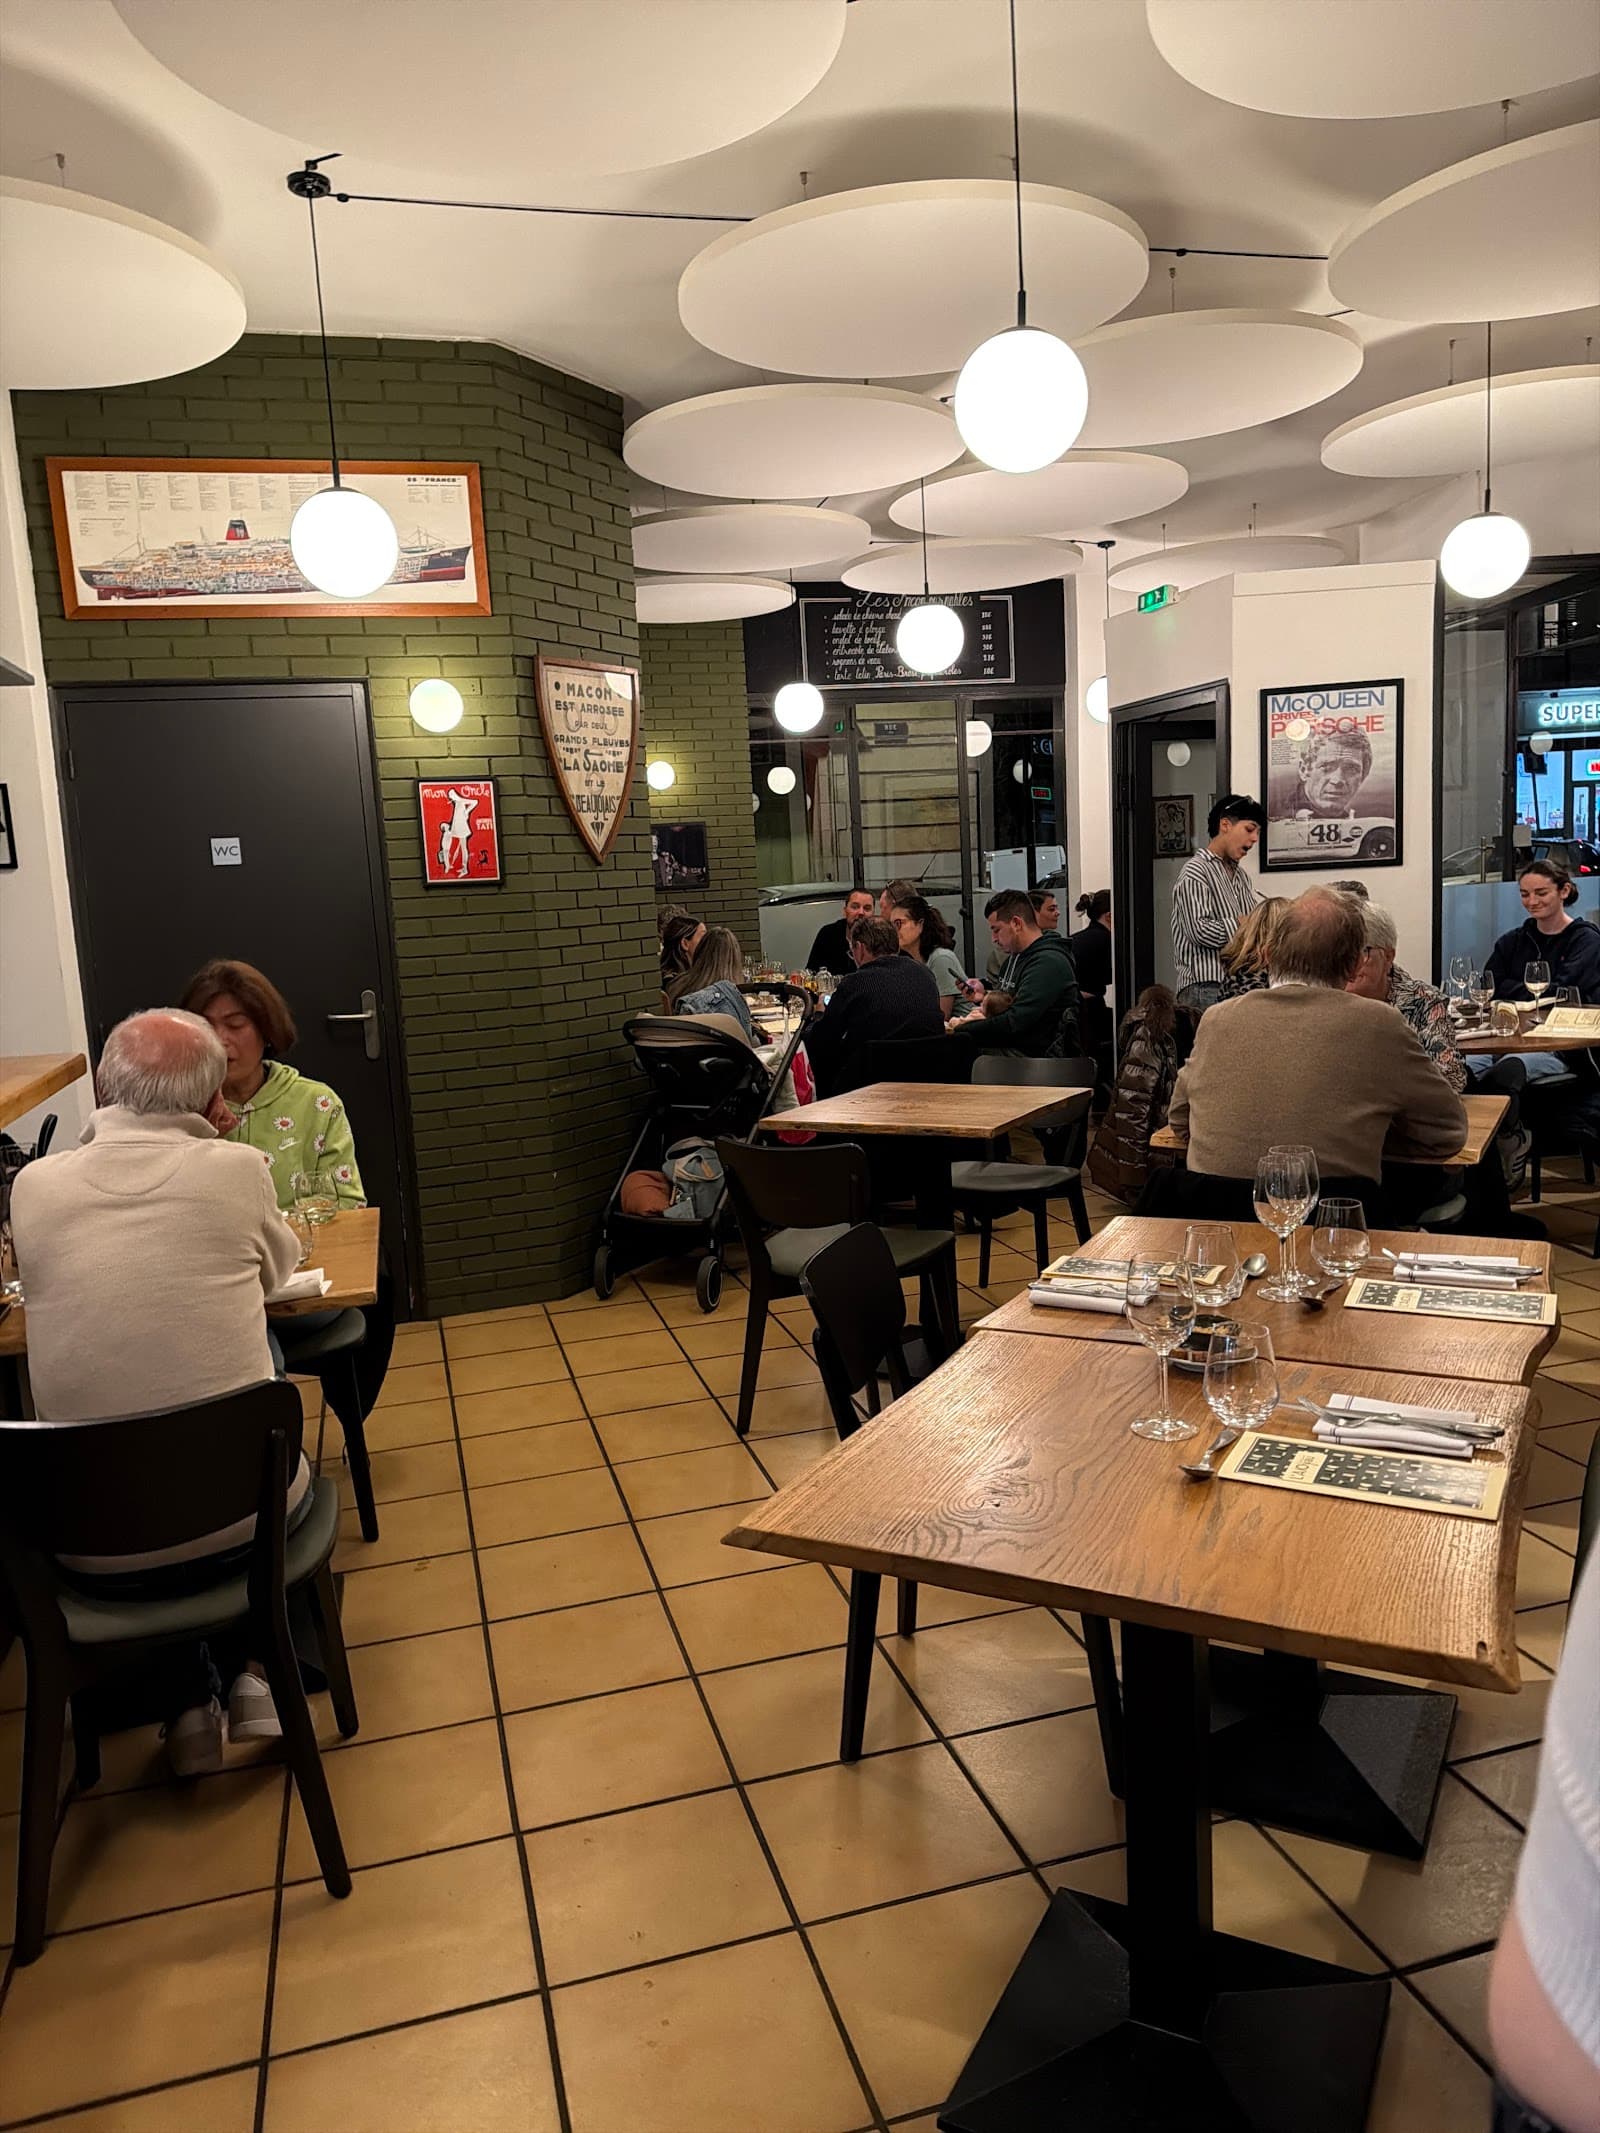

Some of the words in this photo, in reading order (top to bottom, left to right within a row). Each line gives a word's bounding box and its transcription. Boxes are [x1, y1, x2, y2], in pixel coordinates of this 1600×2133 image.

[856, 592, 889, 607] Les
[567, 683, 612, 701] MACON
[555, 700, 575, 712] EST
[580, 703, 625, 717] ARROSEE
[1271, 689, 1385, 714] McQUEEN
[574, 720, 589, 729] PAR
[591, 721, 608, 730] DEUX
[554, 734, 588, 745] GRANDS
[592, 737, 630, 748] FLEUVES
[1309, 823, 1340, 843] 48
[214, 845, 239, 856] WC
